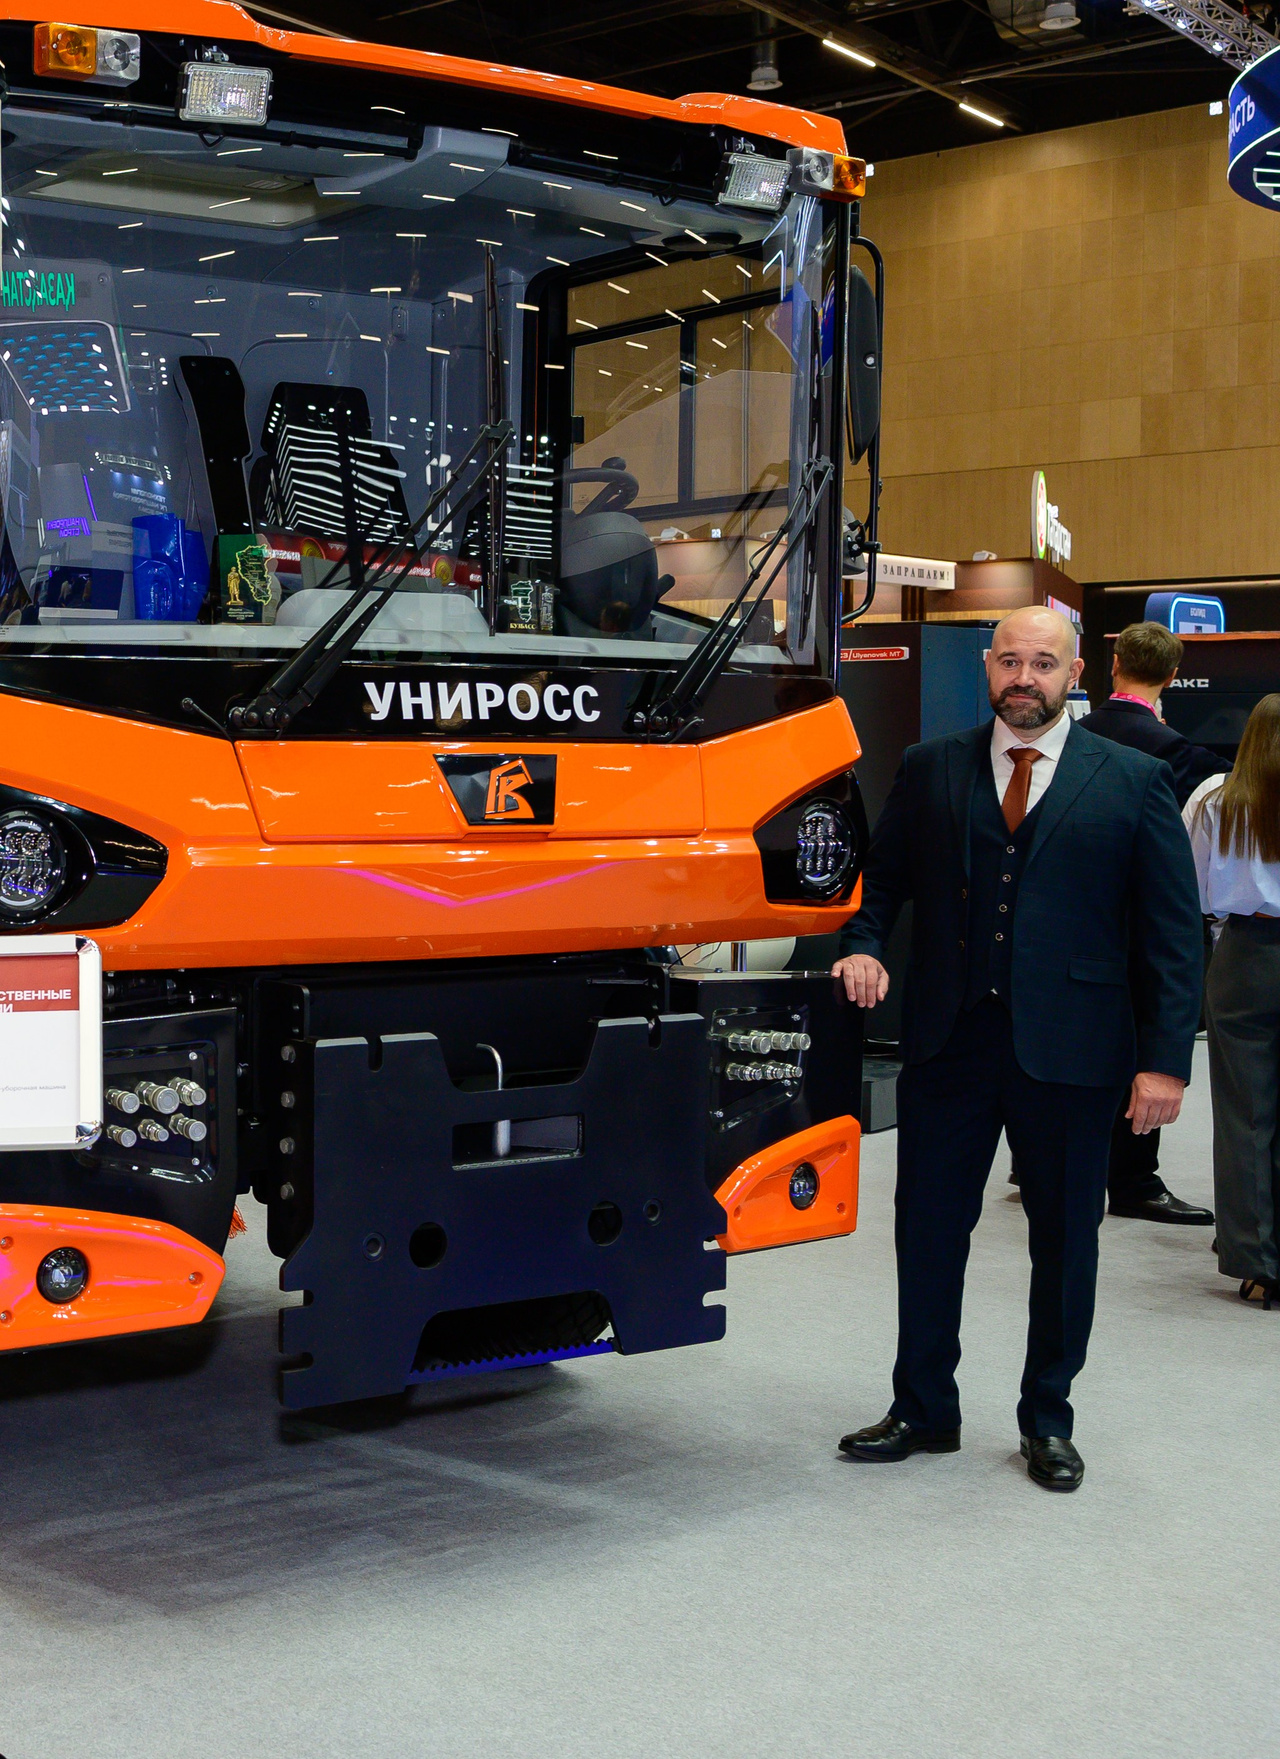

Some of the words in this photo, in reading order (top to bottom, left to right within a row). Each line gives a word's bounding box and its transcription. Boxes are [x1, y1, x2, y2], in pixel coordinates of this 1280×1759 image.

[1228, 95, 1256, 145] АСТЬ
[882, 564, 950, 581] ЗАПРАШАЕМ!
[852, 651, 888, 660] Ulyanovsk
[364, 681, 601, 723] УНИРОСС
